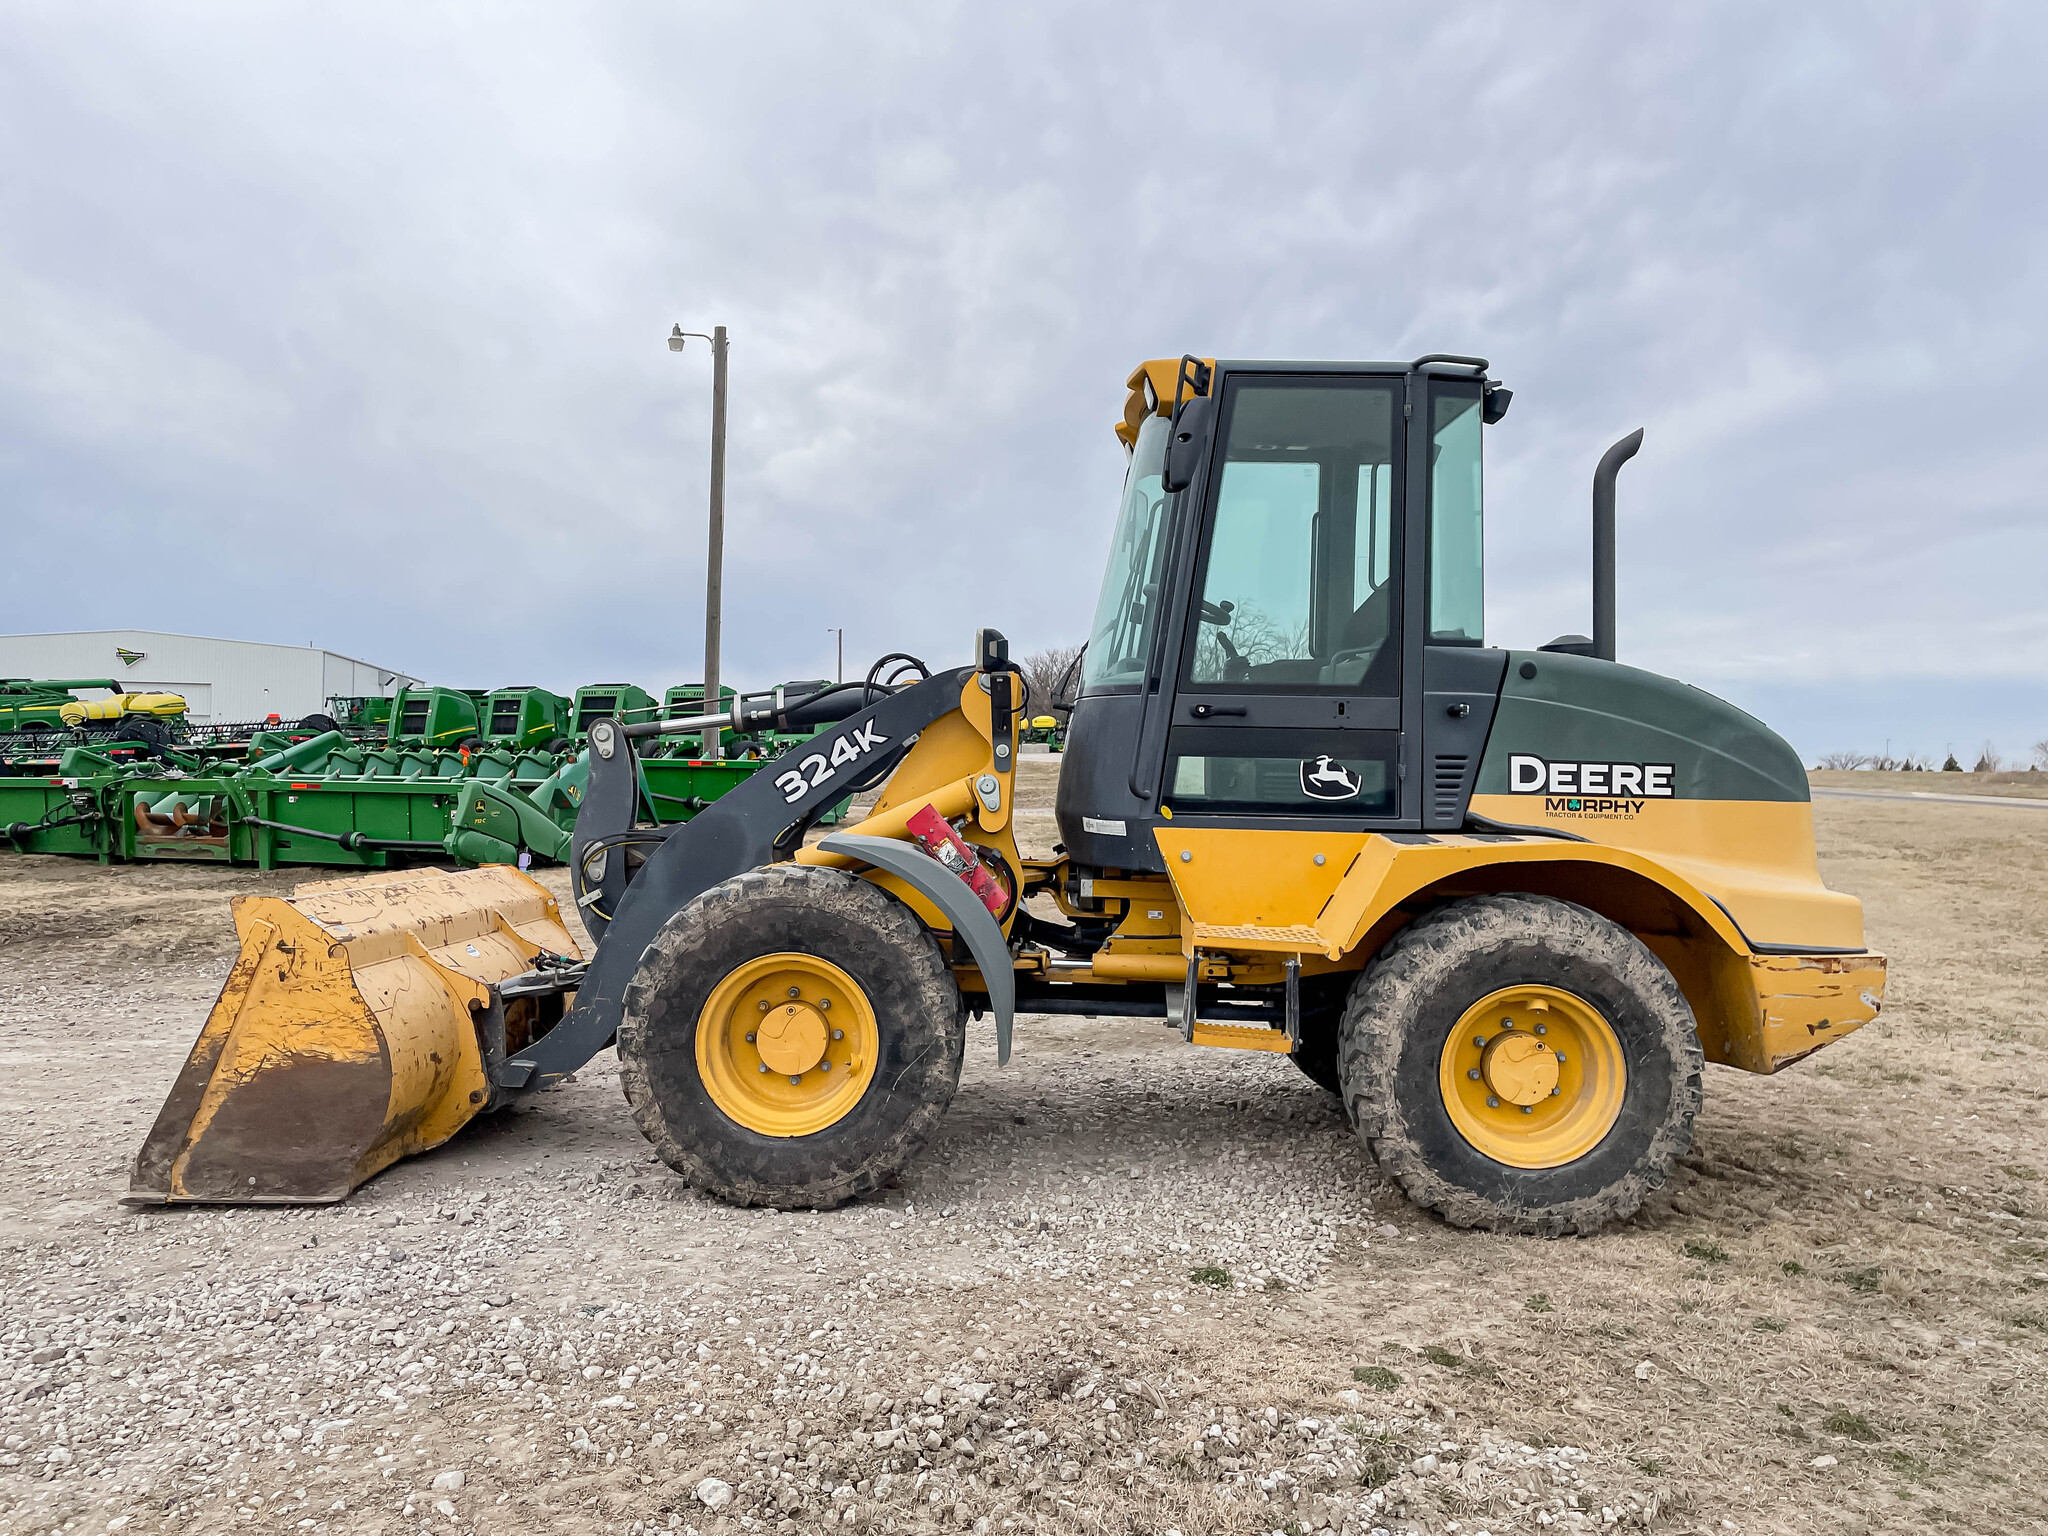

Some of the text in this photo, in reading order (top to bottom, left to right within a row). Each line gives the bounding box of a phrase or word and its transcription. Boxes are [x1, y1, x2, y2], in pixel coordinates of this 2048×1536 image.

[773, 717, 889, 804] 324K
[1509, 755, 1673, 796] DEERE
[1545, 798, 1645, 813] MURPHY
[1545, 811, 1577, 819] TRACTOR
